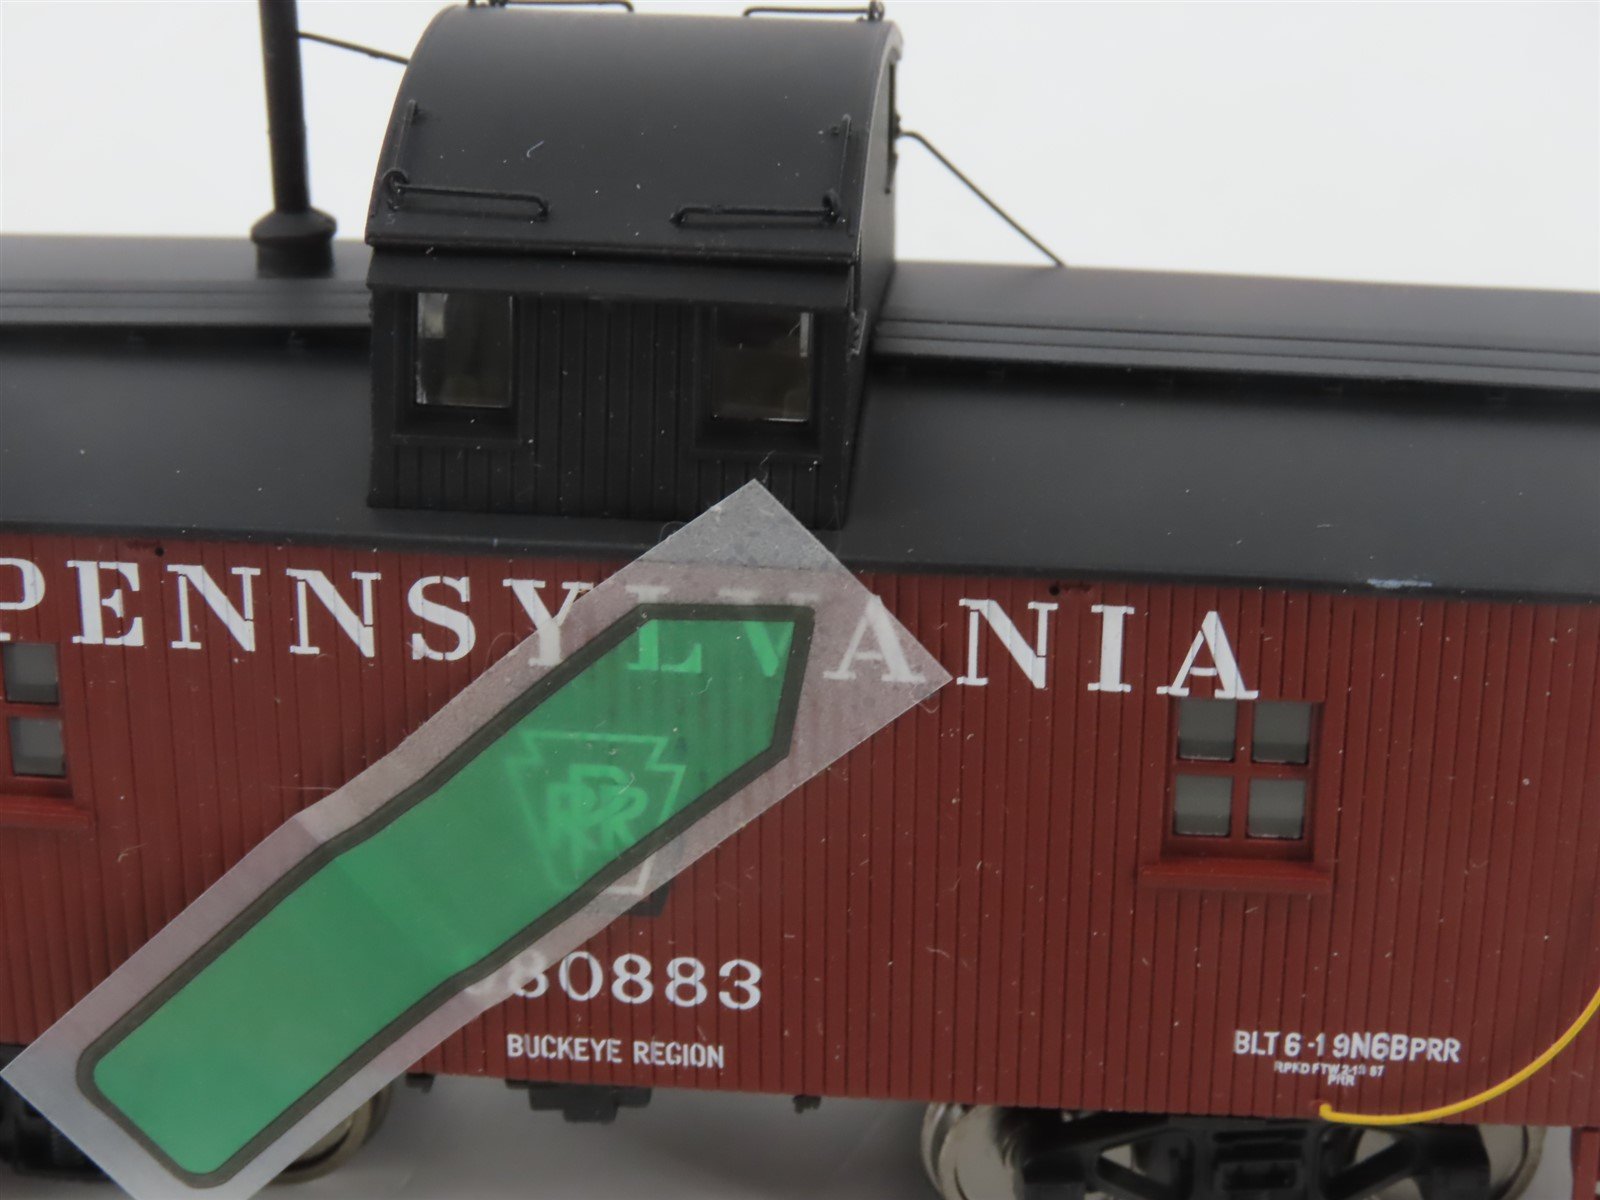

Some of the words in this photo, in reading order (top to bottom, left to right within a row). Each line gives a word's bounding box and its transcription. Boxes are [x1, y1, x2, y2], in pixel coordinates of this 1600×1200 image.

[506, 1033, 622, 1064] BUCKEYE
[633, 1041, 724, 1069] REGION
[1234, 1029, 1280, 1056] BLT
